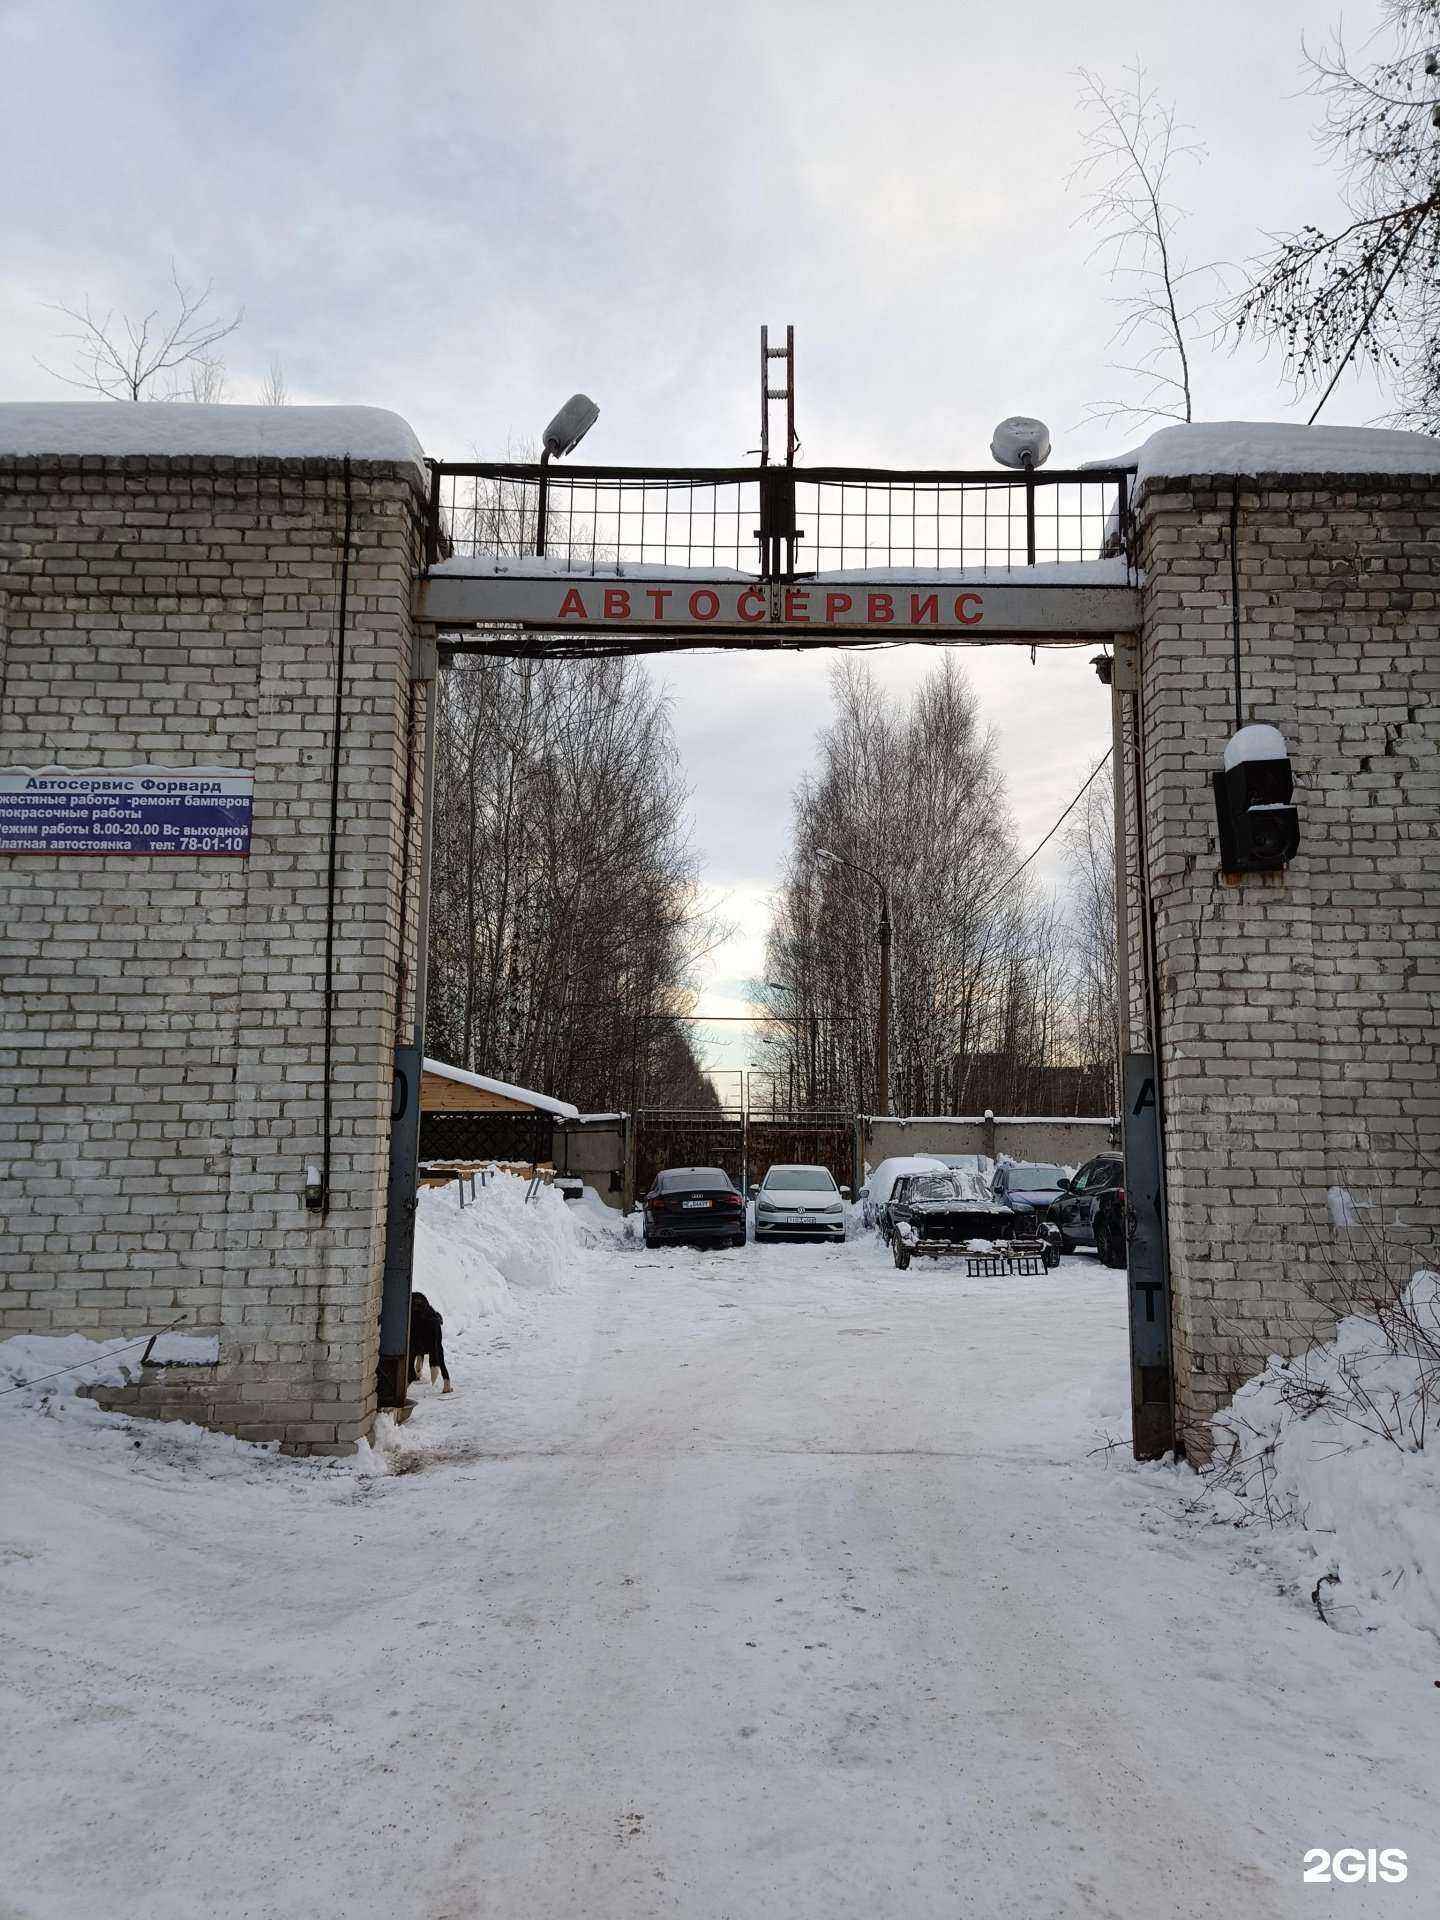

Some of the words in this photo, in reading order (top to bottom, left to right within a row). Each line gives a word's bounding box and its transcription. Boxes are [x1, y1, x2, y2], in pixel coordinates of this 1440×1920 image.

[558, 587, 984, 625] АВТОСЕРВИС
[25, 777, 134, 792] Автосервис
[141, 779, 221, 793] Форвард
[70, 794, 119, 807] работы
[184, 796, 250, 808] бамперов
[92, 807, 141, 820] работы
[0, 823, 37, 834] ежим
[41, 823, 89, 836] работы
[93, 823, 159, 835] 8.00-20.00
[163, 824, 180, 835] Вс
[183, 825, 249, 837] выходной
[0, 838, 46, 849] латная
[50, 840, 131, 850] автостоянка
[150, 841, 175, 850] тел:
[180, 838, 242, 850] 78-01-10
